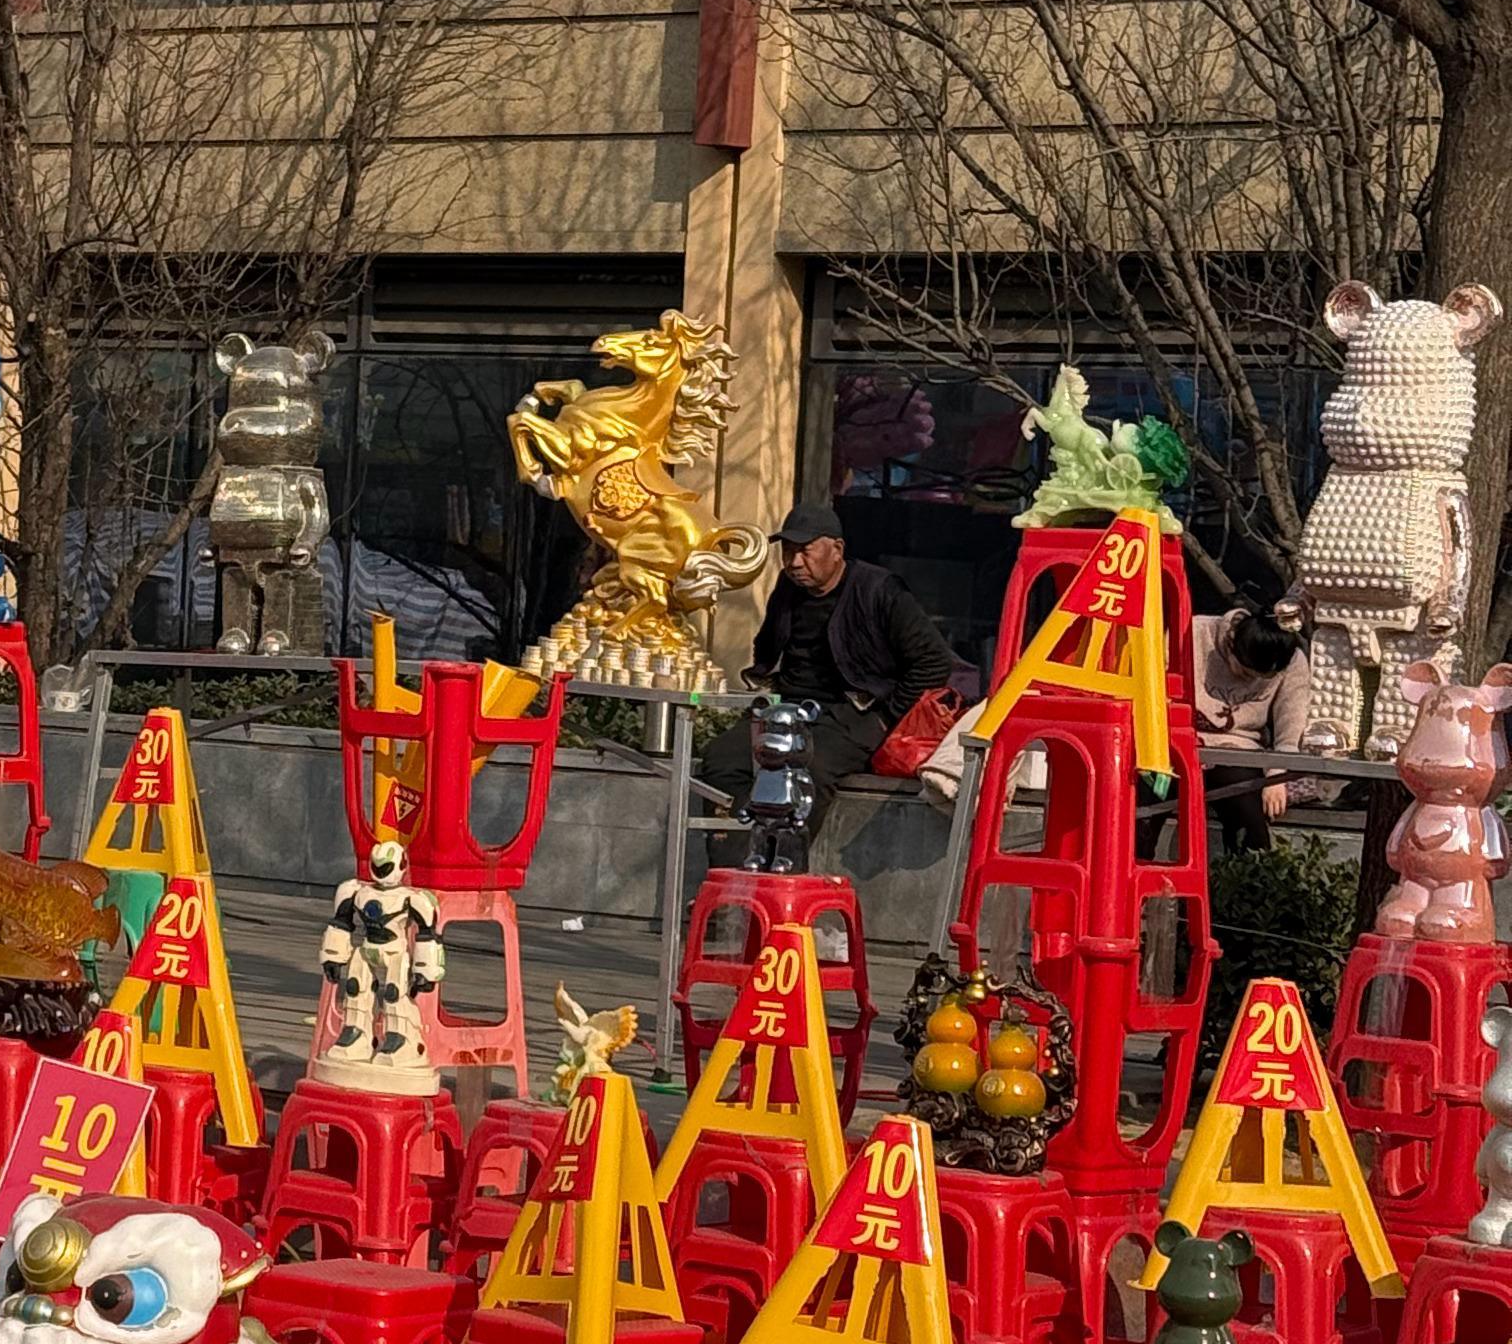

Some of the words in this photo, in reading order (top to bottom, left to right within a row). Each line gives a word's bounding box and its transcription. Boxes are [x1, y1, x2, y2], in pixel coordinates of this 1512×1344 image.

[1097, 533, 1145, 579] 30
[1088, 581, 1126, 616] 元
[136, 728, 170, 765] 30
[133, 770, 160, 799] 元
[154, 893, 202, 938] 20
[153, 943, 190, 978] 元
[753, 946, 800, 995] 30
[749, 1000, 787, 1038] 元
[1246, 1002, 1303, 1054] 20
[82, 1026, 124, 1075] 10
[1251, 1061, 1296, 1102] 元
[39, 1095, 117, 1160] 10
[565, 1095, 597, 1146] 10
[549, 1155, 578, 1192] 元
[861, 1139, 917, 1198] 10
[851, 1203, 901, 1251] 元
